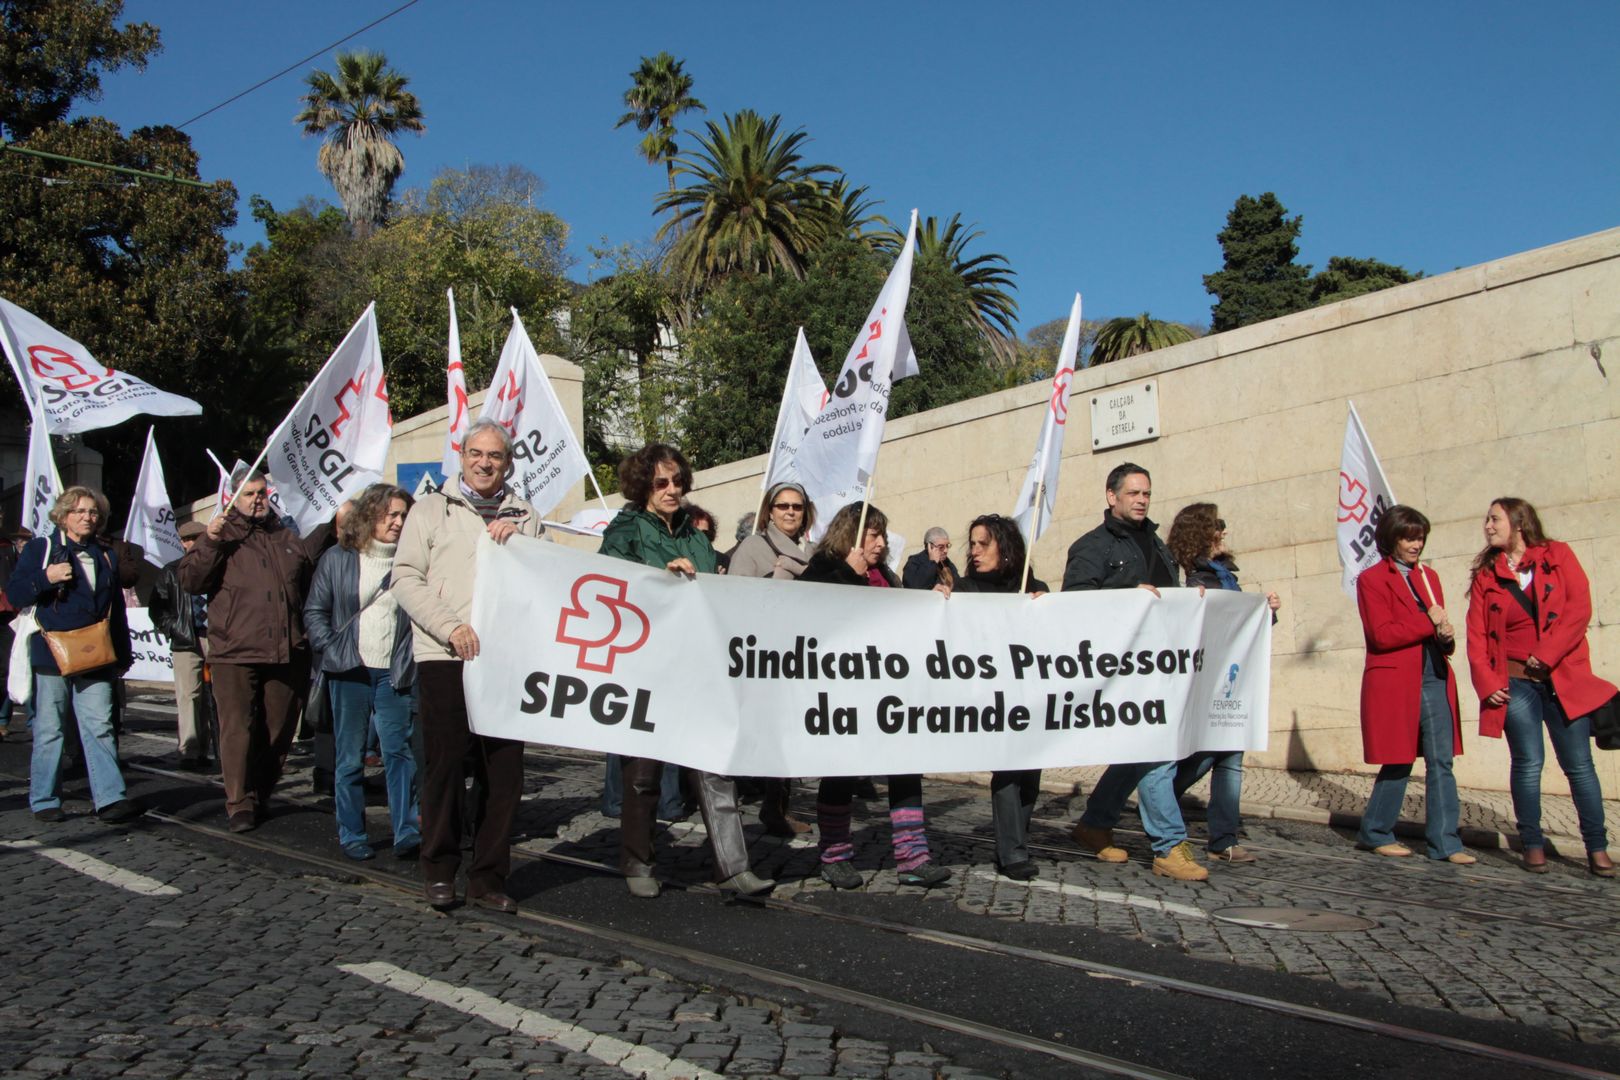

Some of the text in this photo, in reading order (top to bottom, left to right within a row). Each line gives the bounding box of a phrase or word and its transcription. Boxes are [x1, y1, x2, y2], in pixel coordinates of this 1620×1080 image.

[1111, 421, 1135, 436] ESTRELA
[1118, 410, 1126, 420] DA
[304, 413, 354, 494] SPGL
[729, 635, 1205, 680] Sindicato dos Professores
[520, 671, 656, 733] SPGL
[804, 690, 1167, 736] da Grande Lisboa
[1213, 700, 1242, 710] FENPROF
